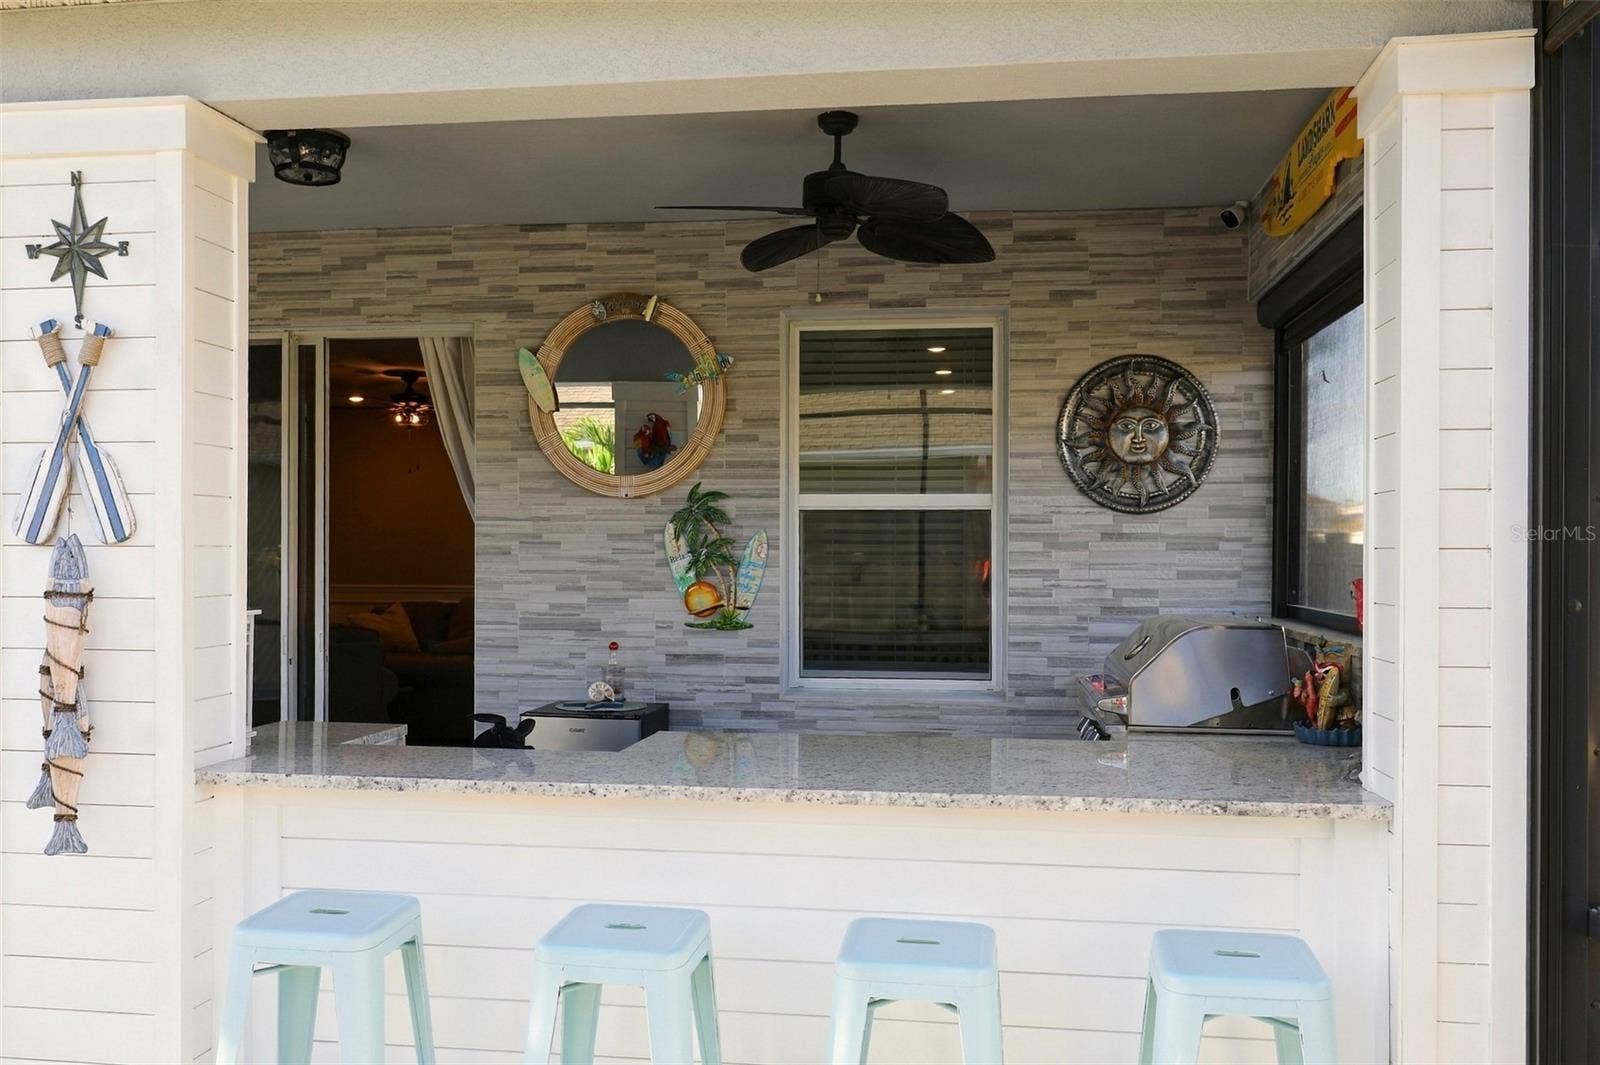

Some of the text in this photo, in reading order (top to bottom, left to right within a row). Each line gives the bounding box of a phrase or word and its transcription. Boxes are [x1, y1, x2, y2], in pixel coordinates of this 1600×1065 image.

[1297, 98, 1336, 167] LANDSHARK
[70, 171, 82, 187] N
[25, 243, 43, 260] W
[117, 241, 129, 257] E
